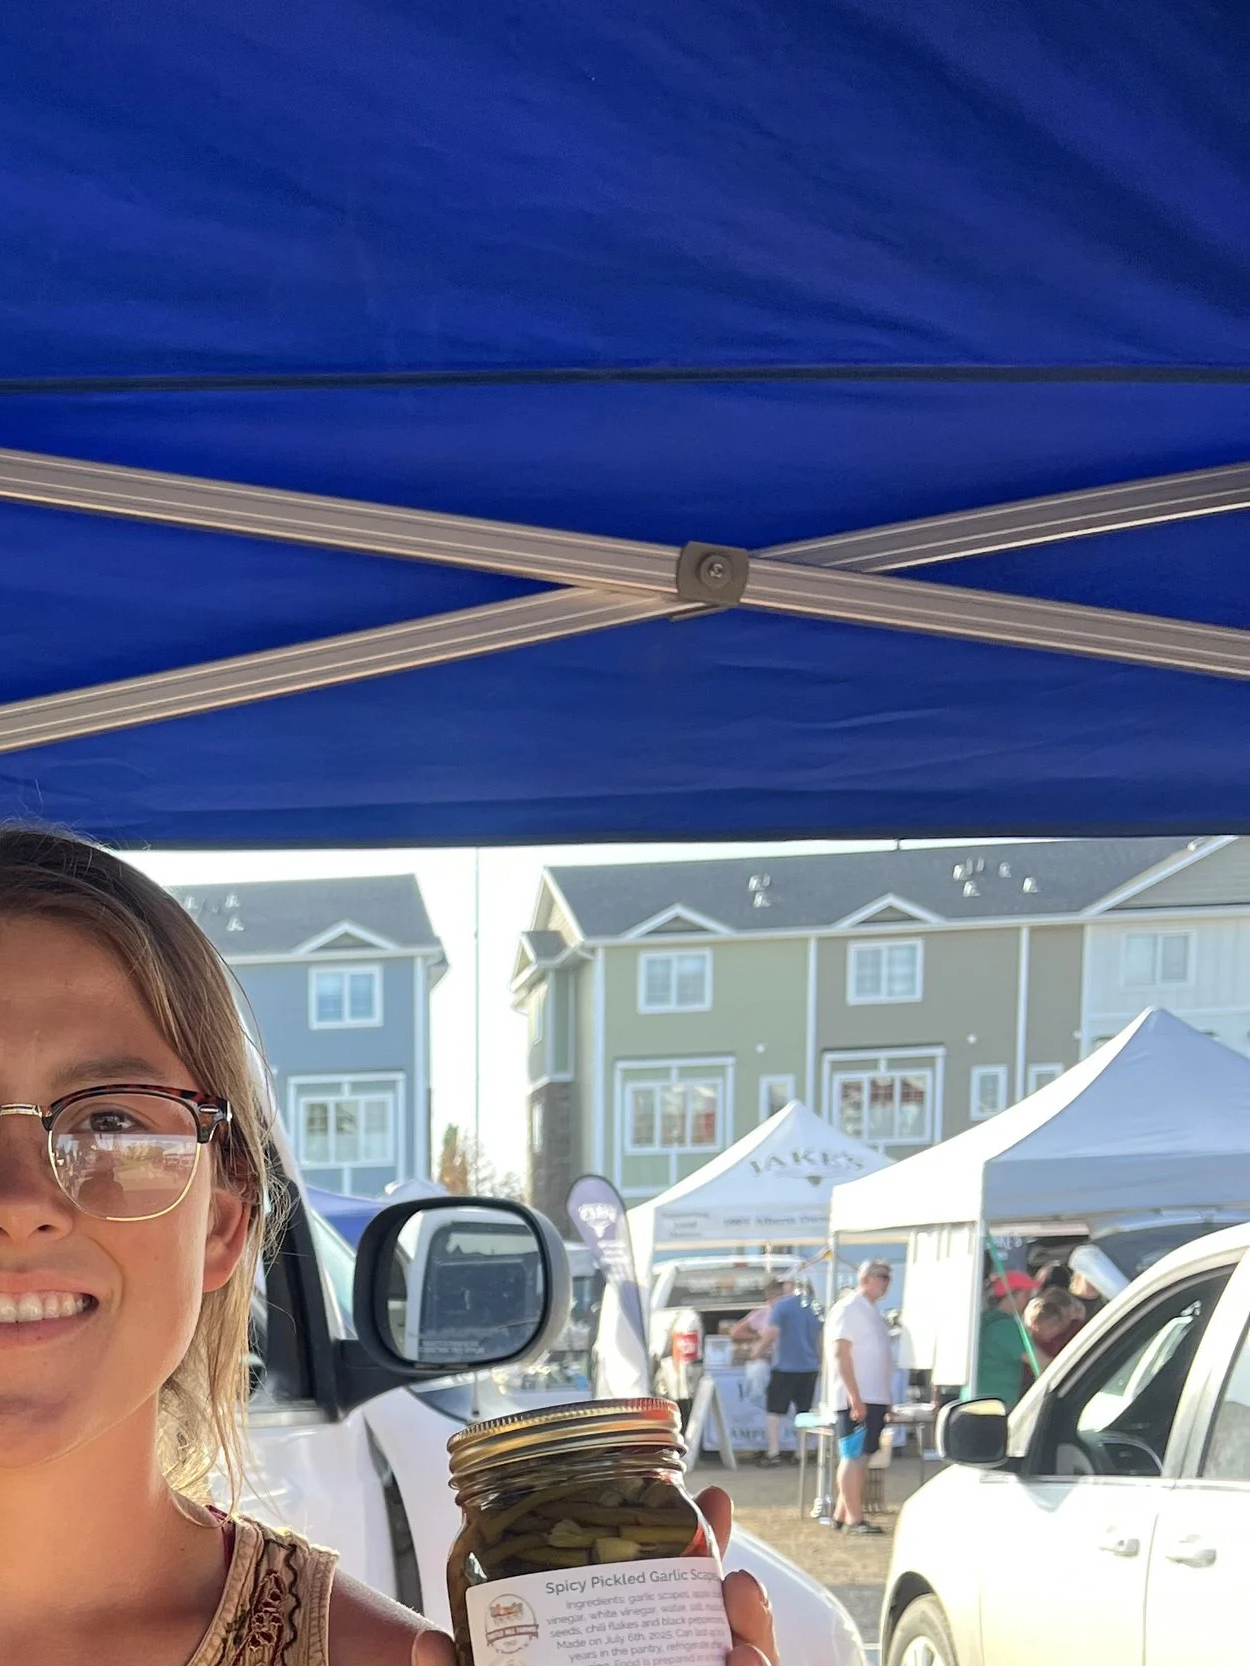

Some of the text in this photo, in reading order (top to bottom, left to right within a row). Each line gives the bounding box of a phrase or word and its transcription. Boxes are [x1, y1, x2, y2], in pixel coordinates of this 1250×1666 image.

[545, 1579, 586, 1595] Spicy
[591, 1572, 646, 1589] Pickled
[650, 1569, 688, 1582] Garlic
[628, 1591, 656, 1605] garlic
[589, 1607, 617, 1620] white
[608, 1618, 638, 1631] flakes
[641, 1616, 660, 1627] and
[661, 1614, 687, 1626] black
[556, 1639, 586, 1650] Made
[588, 1637, 601, 1646] on
[605, 1634, 625, 1646] July
[568, 1651, 598, 1663] years
[600, 1647, 610, 1658] in
[611, 1645, 629, 1657] the
